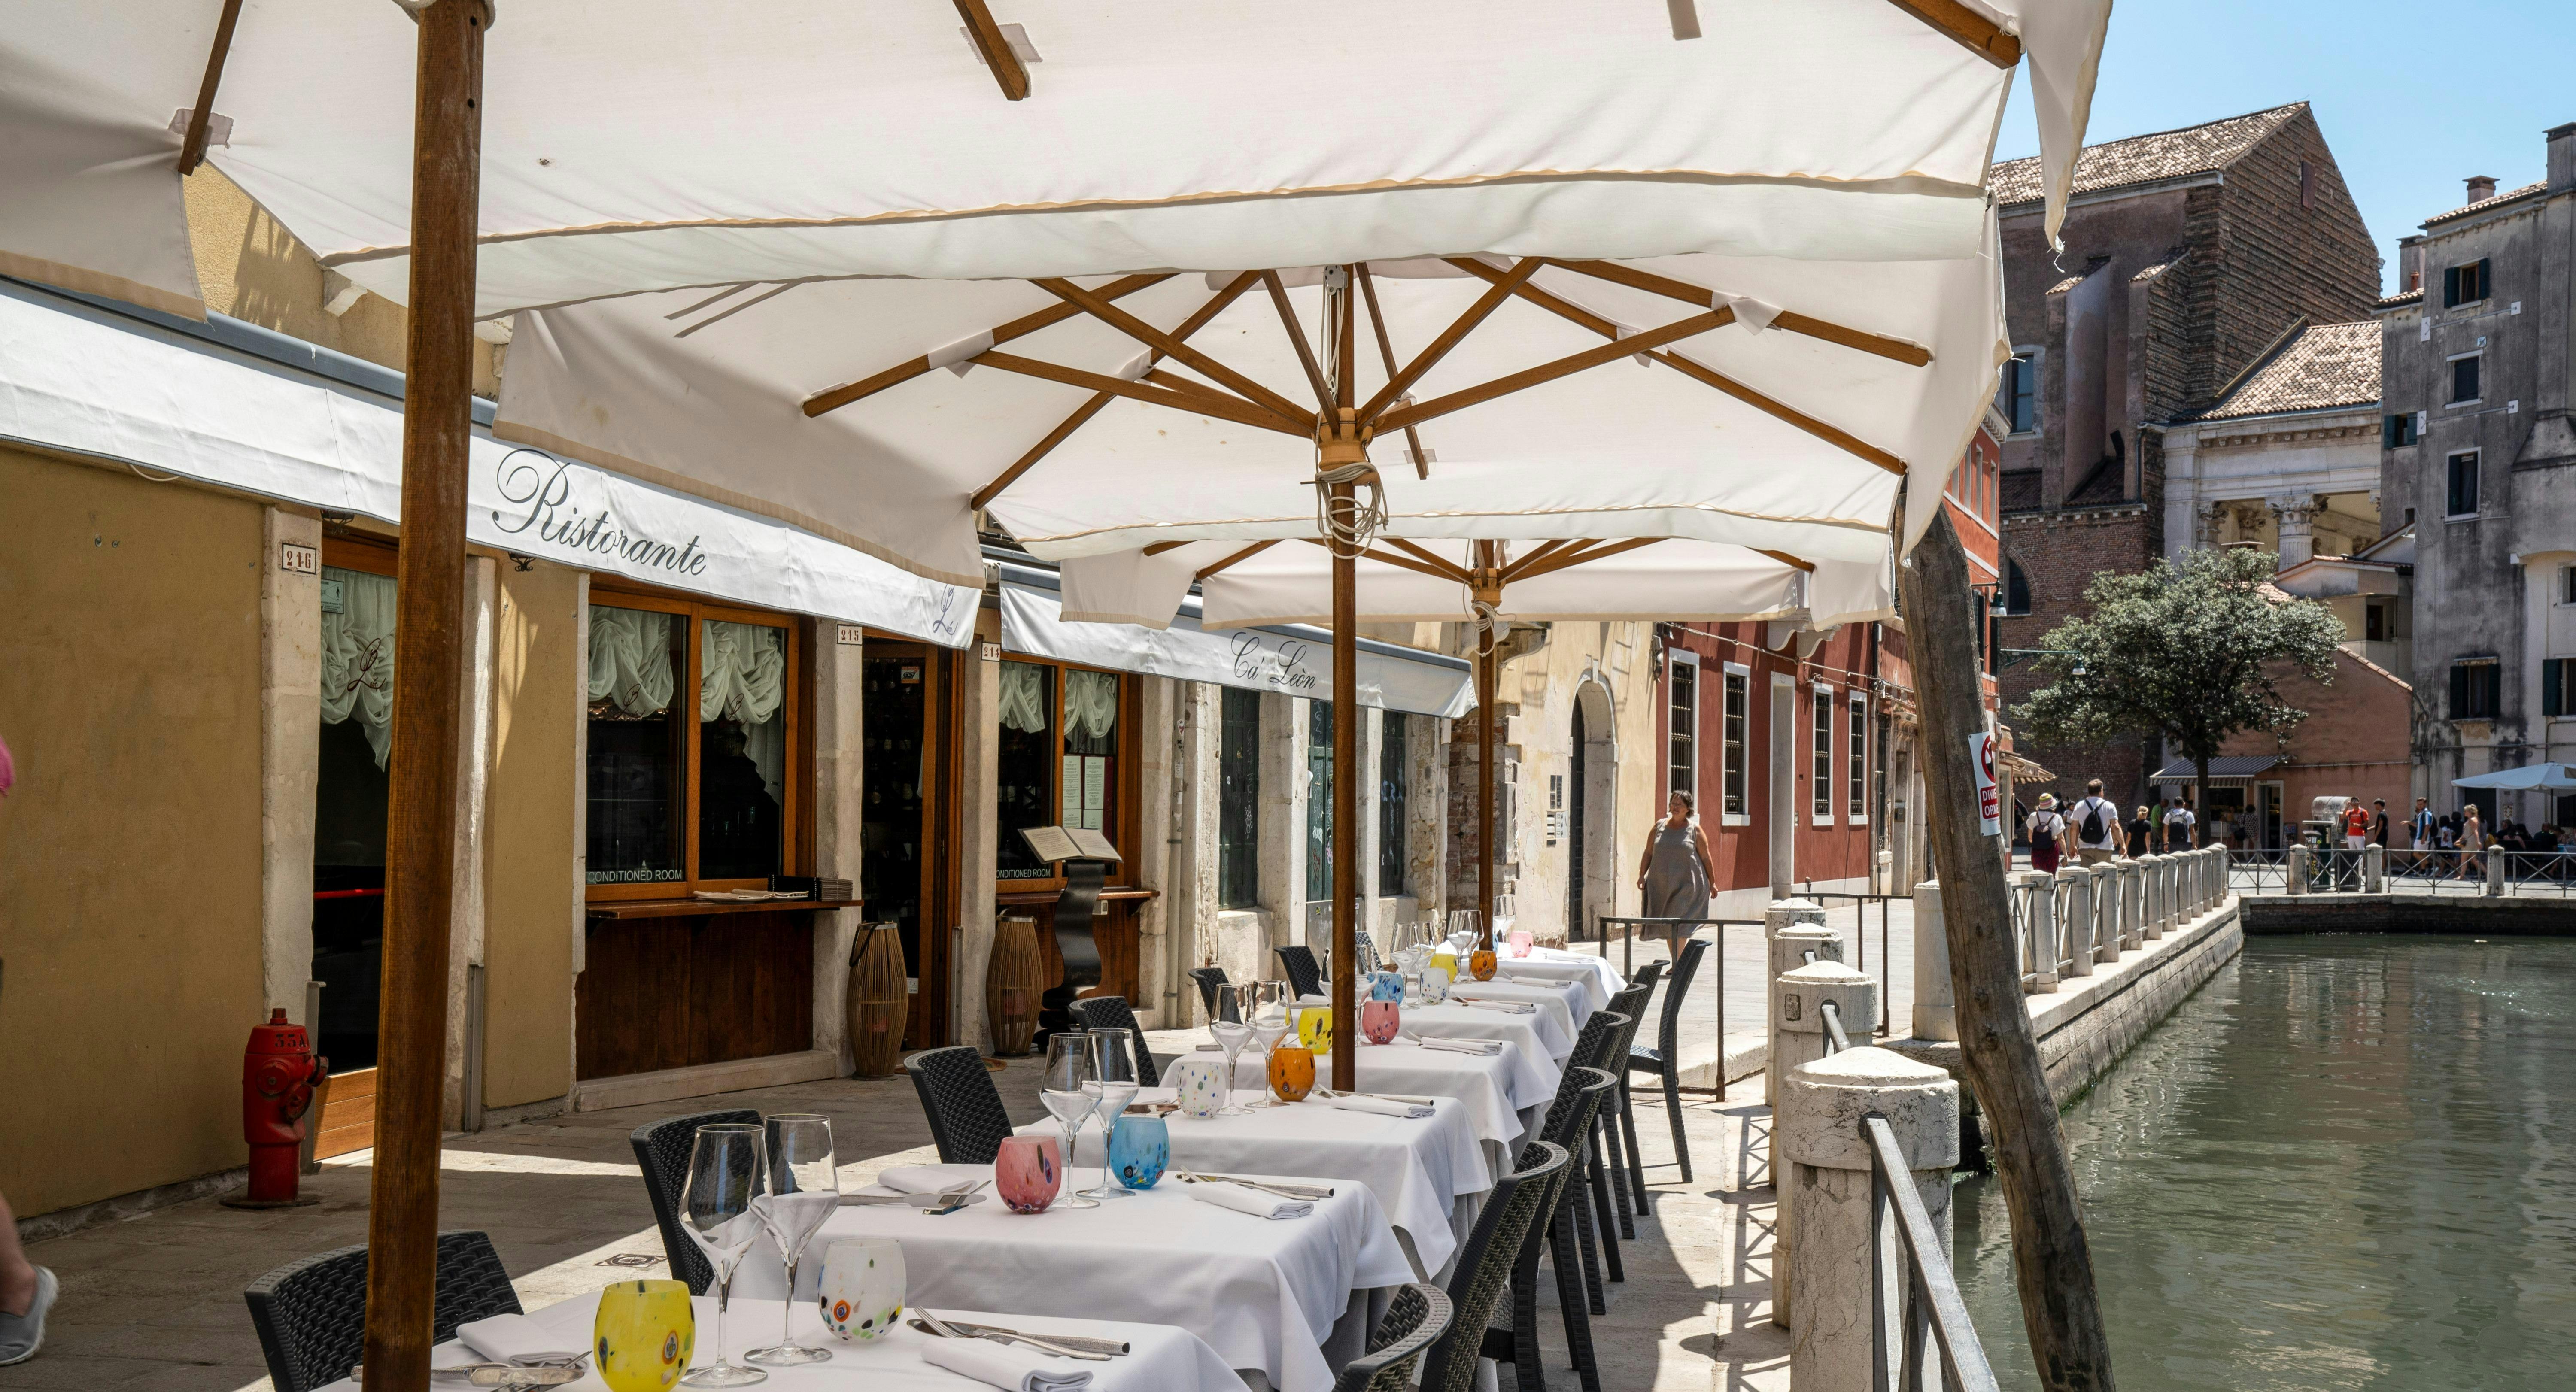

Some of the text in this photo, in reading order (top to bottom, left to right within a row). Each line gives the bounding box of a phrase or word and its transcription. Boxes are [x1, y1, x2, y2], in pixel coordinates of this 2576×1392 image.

[492, 448, 706, 576] Ristorante
[286, 550, 311, 569] 216
[841, 629, 859, 641] 215
[984, 646, 999, 658] 214
[588, 869, 682, 883] CONDITIONED ROOM
[1033, 868, 1051, 877] ROOM
